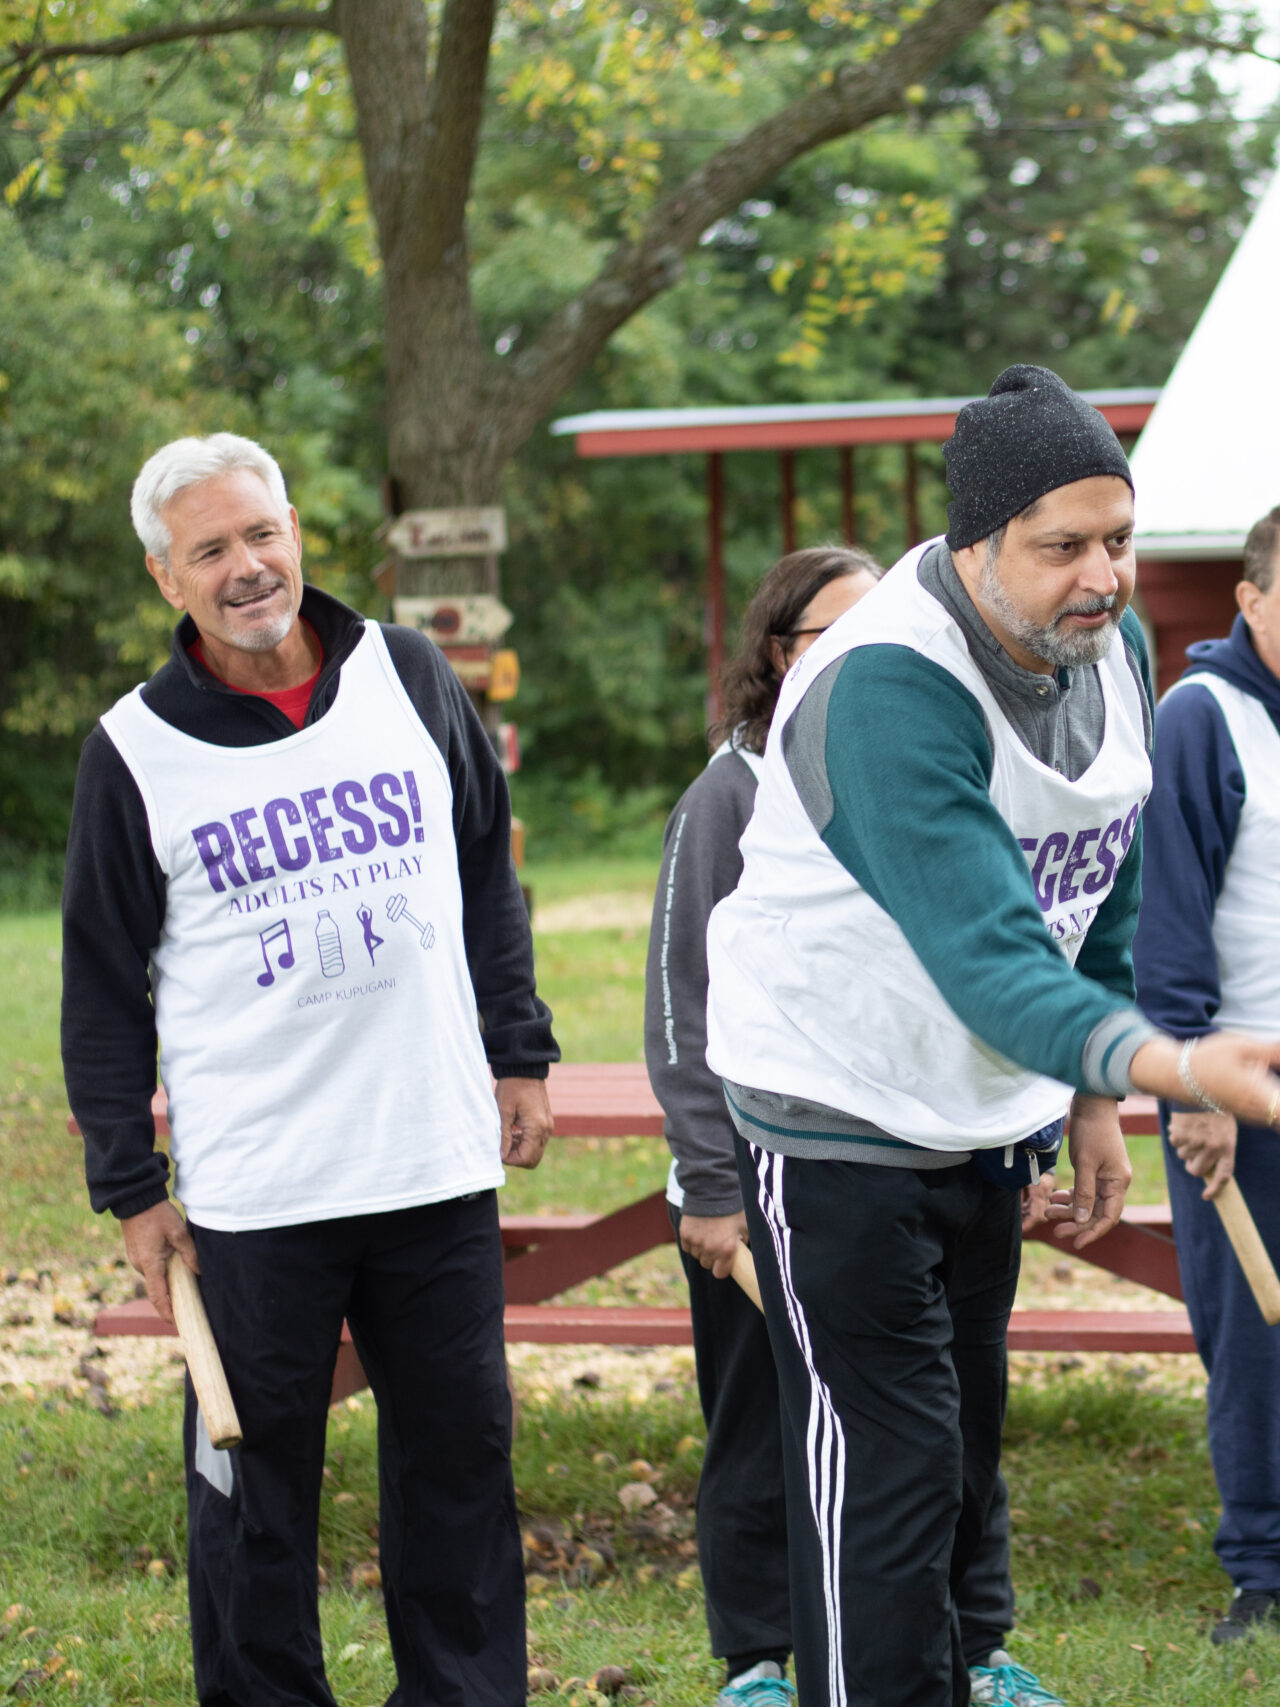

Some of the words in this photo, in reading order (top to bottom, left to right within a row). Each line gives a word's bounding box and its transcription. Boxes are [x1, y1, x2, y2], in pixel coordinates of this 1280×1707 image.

[191, 770, 425, 893] RECESS!
[228, 877, 324, 916] ADULTS
[332, 868, 361, 893] AT
[368, 855, 424, 884] PLAY
[666, 886, 674, 910] way
[661, 943, 669, 967] find
[298, 991, 332, 1009] CAMP
[336, 978, 396, 1001] KUPUGANI
[663, 969, 672, 1016] families
[665, 1018, 678, 1065] helping
